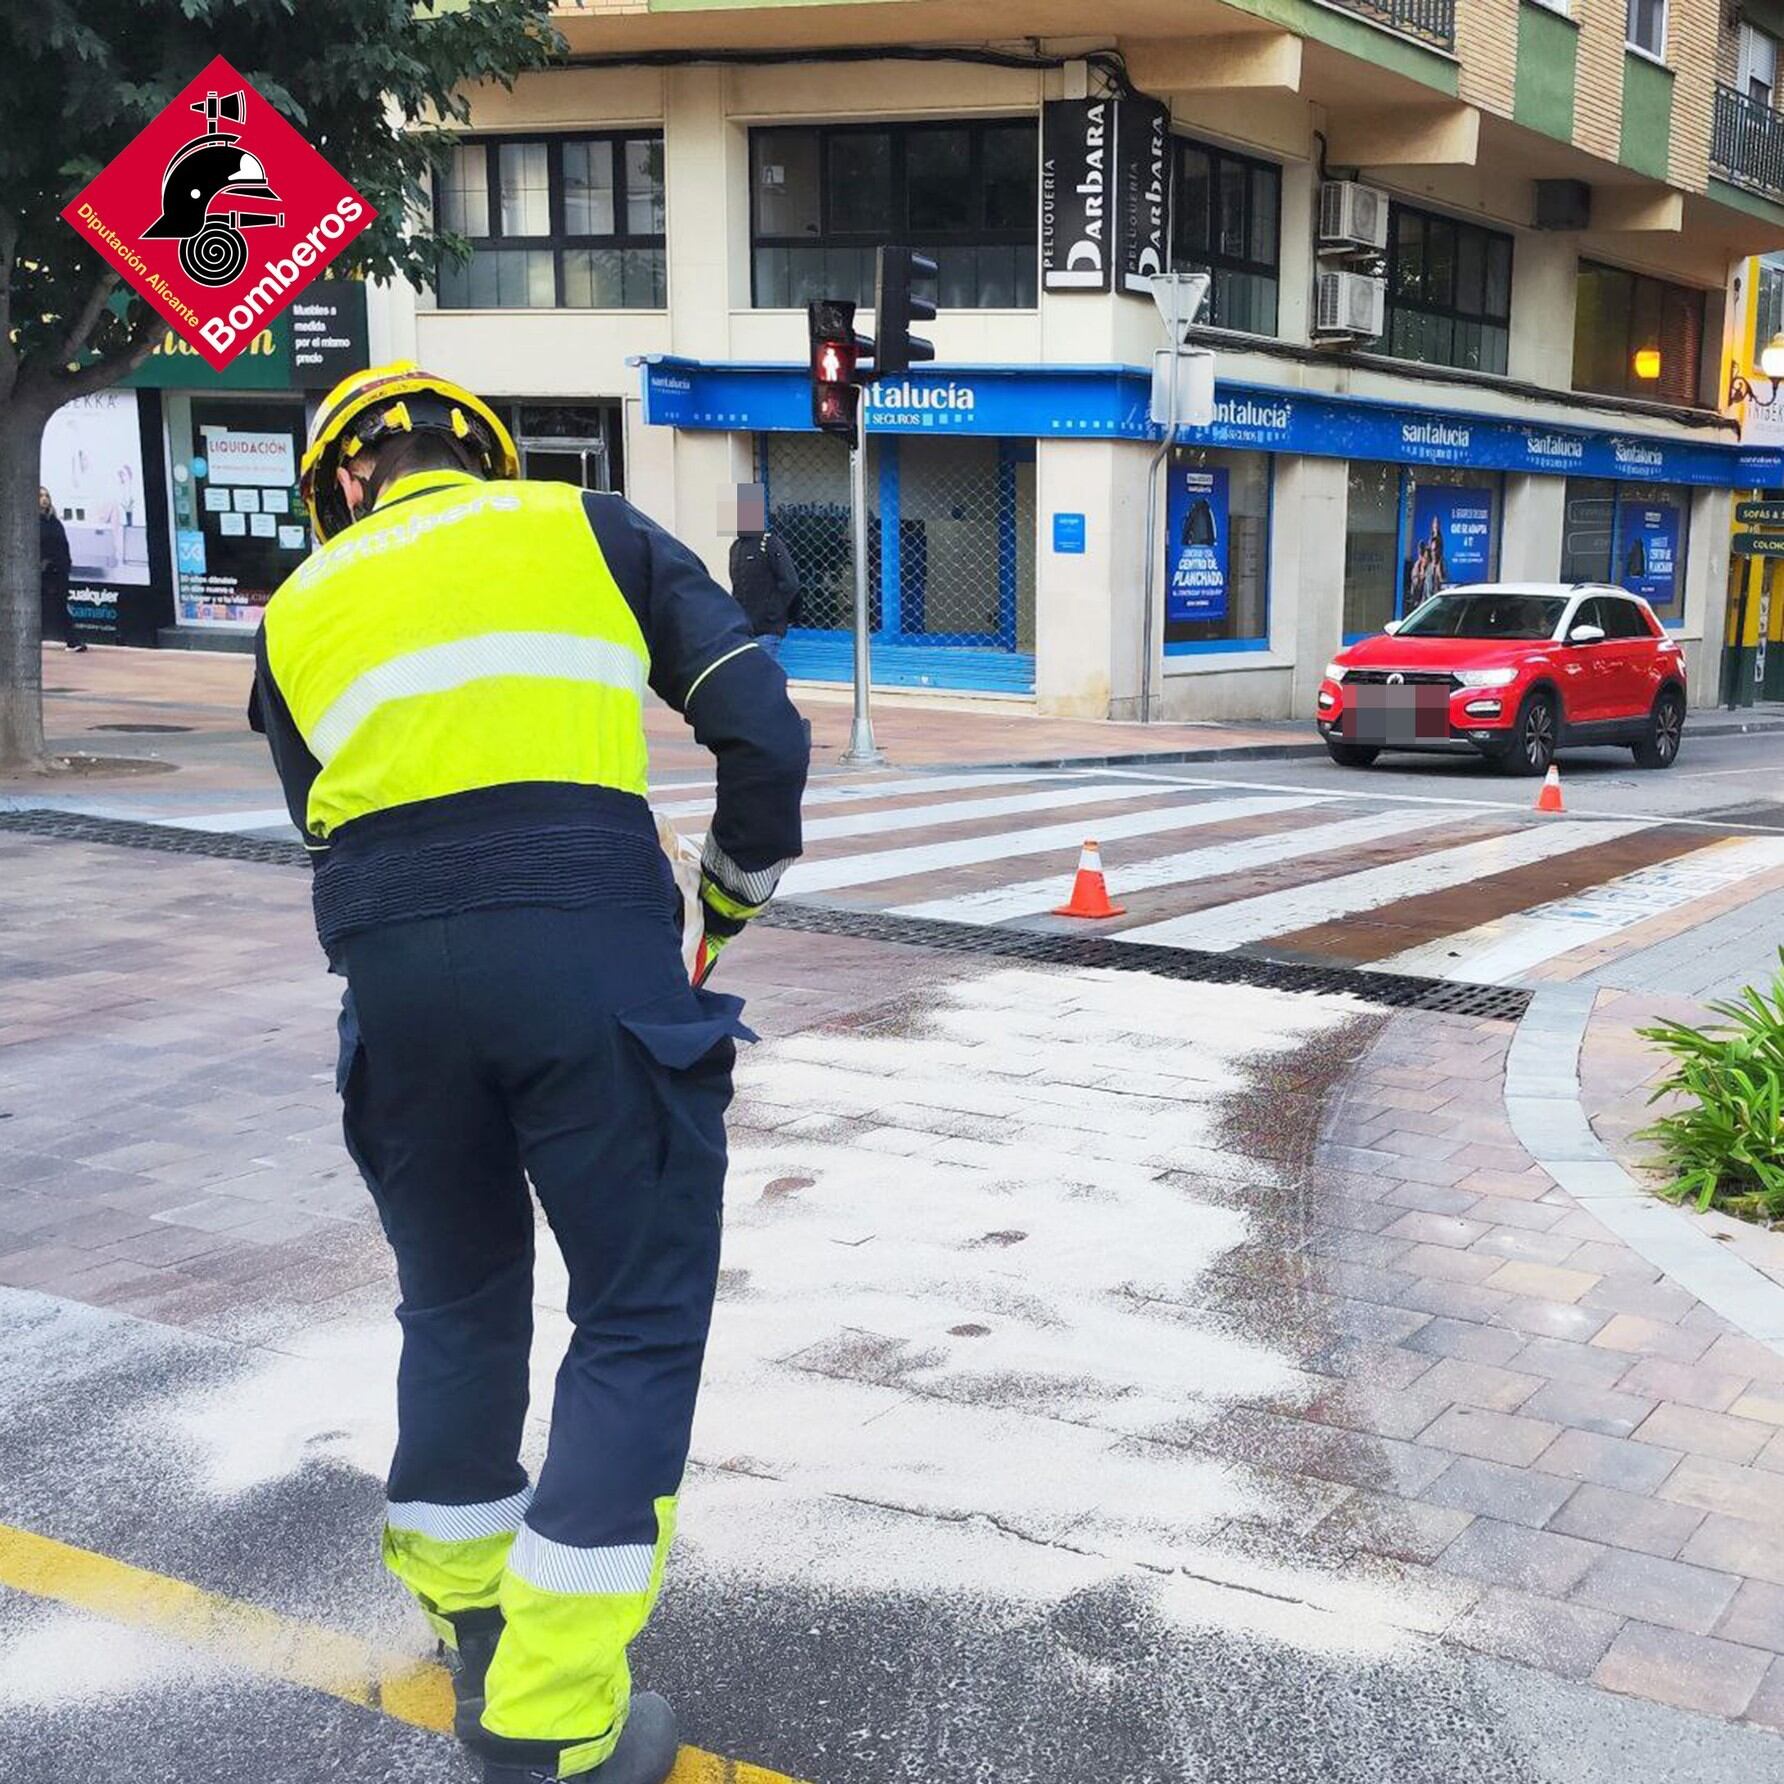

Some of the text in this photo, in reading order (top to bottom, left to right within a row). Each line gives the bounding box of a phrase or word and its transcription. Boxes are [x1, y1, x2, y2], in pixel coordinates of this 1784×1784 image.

[294, 320, 327, 332] medida
[295, 338, 310, 351] por
[321, 336, 351, 348] mismo
[295, 352, 323, 366] precio
[864, 381, 975, 410] talucía
[872, 412, 921, 426] SEGUROS
[1213, 399, 1287, 429] ntalucía
[1172, 570, 1224, 587] PLANCHADO
